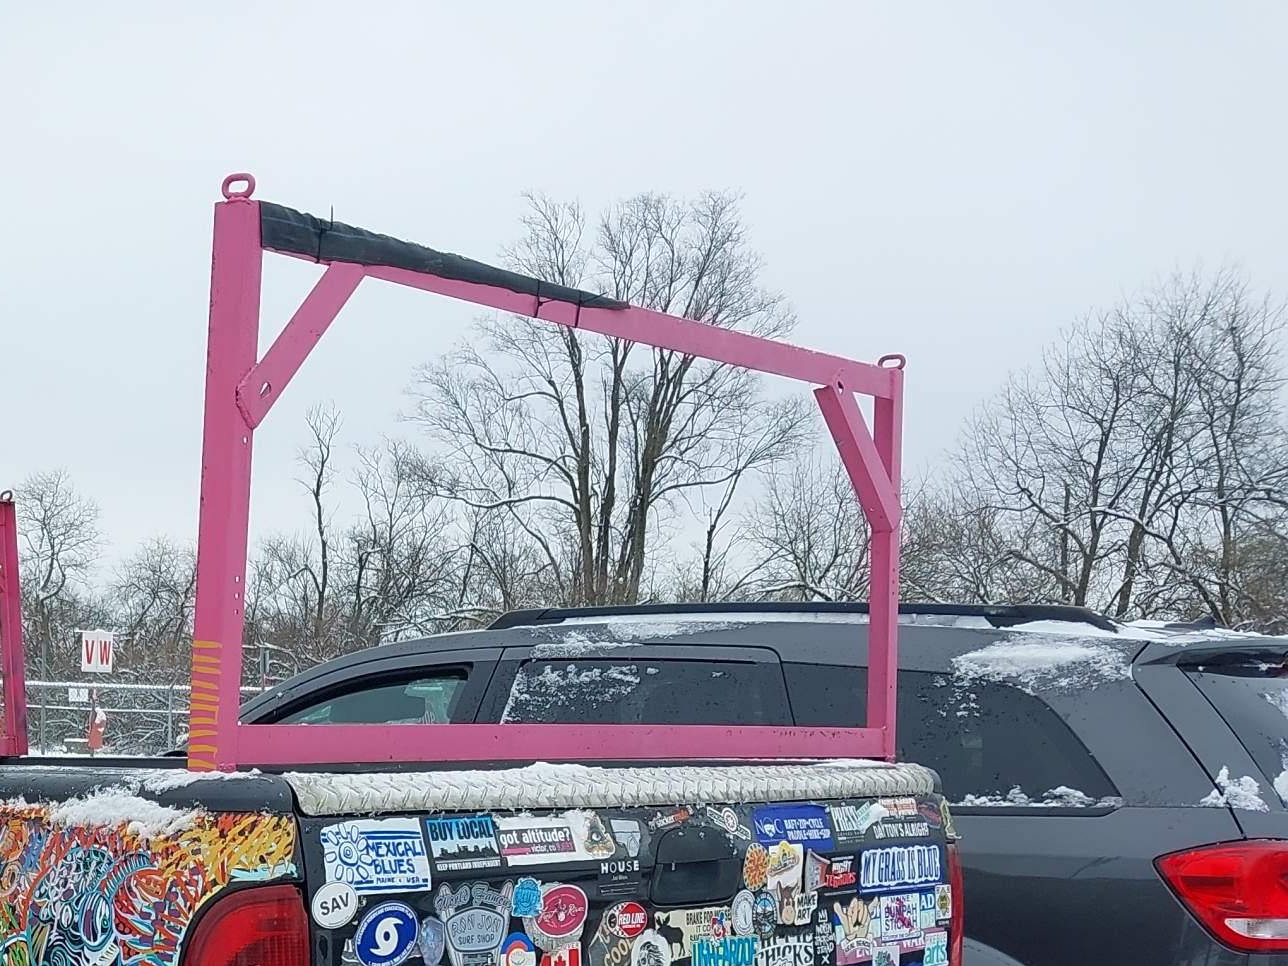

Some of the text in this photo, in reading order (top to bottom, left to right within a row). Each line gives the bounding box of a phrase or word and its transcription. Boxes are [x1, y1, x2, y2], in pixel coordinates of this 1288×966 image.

[85, 639, 111, 665] VW
[430, 818, 494, 841] BUY LOCAL
[499, 827, 570, 848] got altitude?
[366, 840, 425, 858] MEXICALI
[374, 858, 416, 875] BLUES
[600, 860, 640, 874] HOUSE
[862, 846, 939, 886] MY GRASS IS BLUE
[319, 892, 349, 916] SAV
[796, 892, 817, 908] MAKE
[618, 912, 645, 924] RED LINE
[685, 911, 703, 925] BRAKE
[796, 907, 811, 921] ART
[452, 913, 501, 937] RON JON
[458, 934, 495, 945] SURF SHOP
[924, 941, 947, 965] arts
